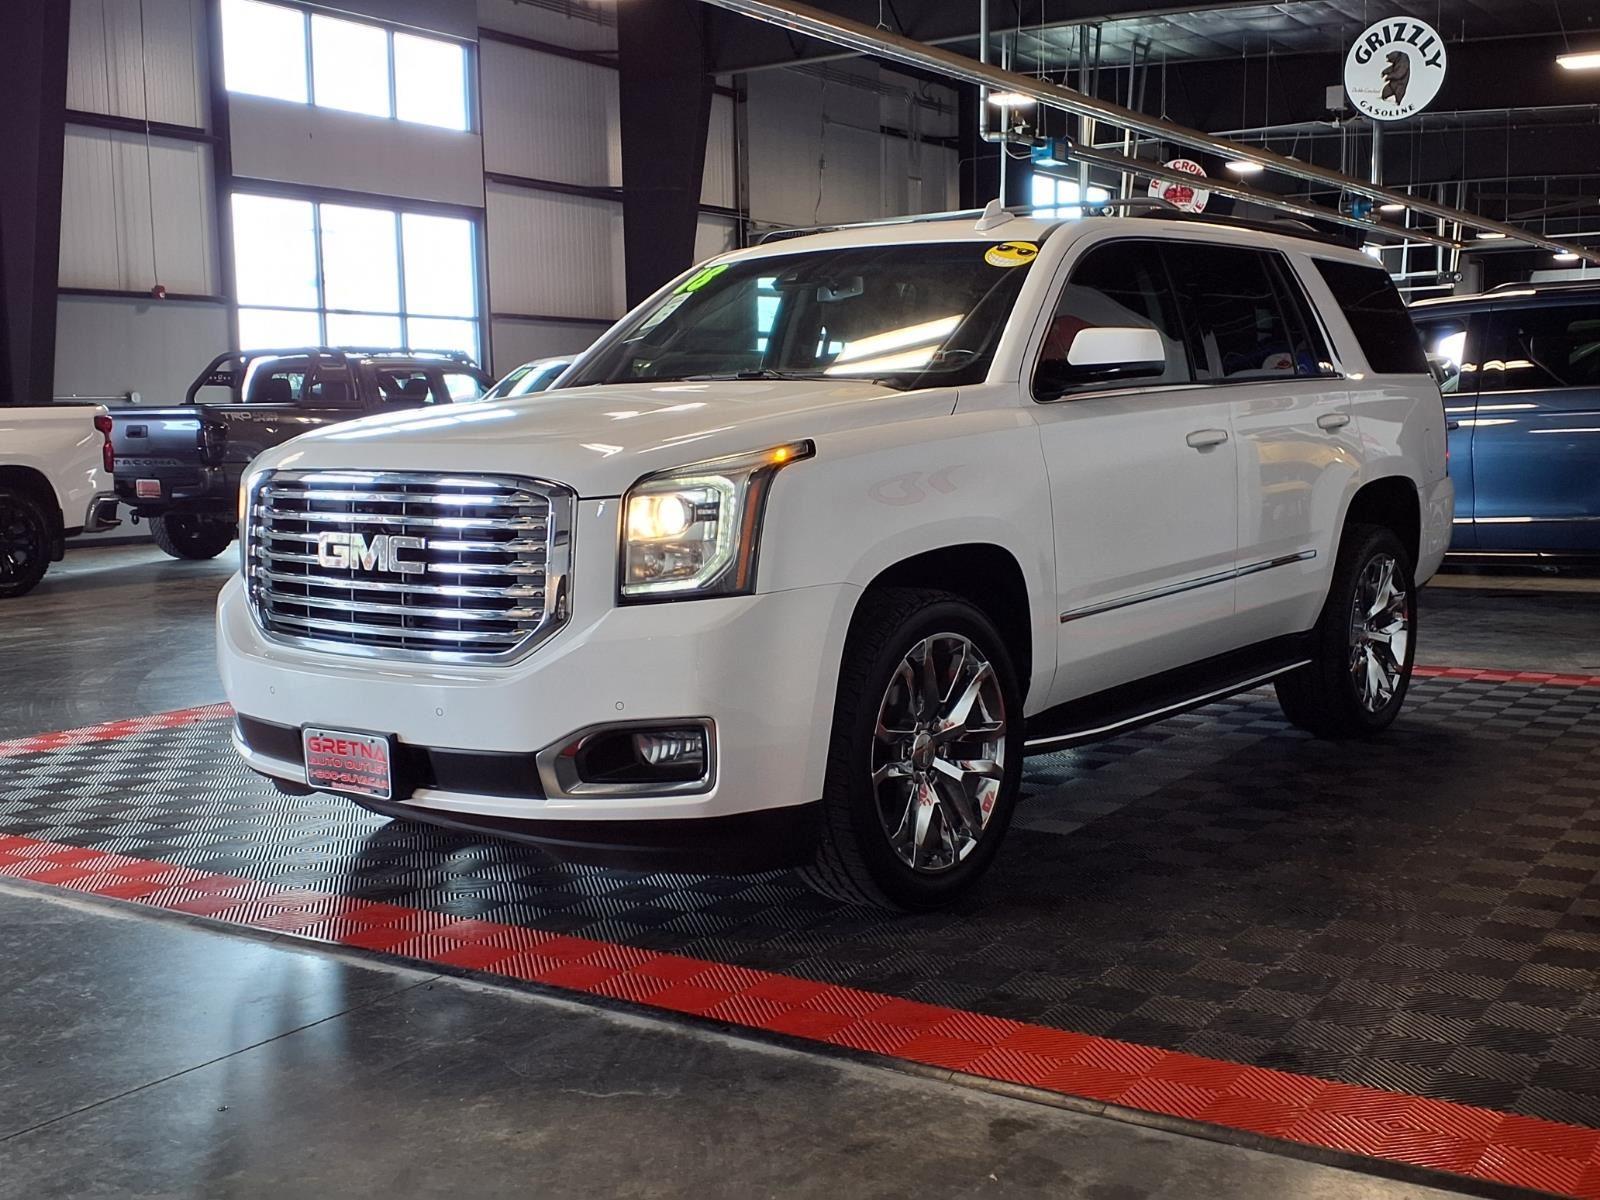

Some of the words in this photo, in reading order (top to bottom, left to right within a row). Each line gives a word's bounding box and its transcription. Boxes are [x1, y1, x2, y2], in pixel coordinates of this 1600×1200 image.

[1355, 22, 1442, 68] GRIZZLY
[1360, 100, 1415, 117] GASOLINE
[1173, 161, 1204, 177] CROW
[319, 531, 426, 575] GMC
[308, 737, 386, 762] GRETNA
[308, 757, 342, 768] AUTO
